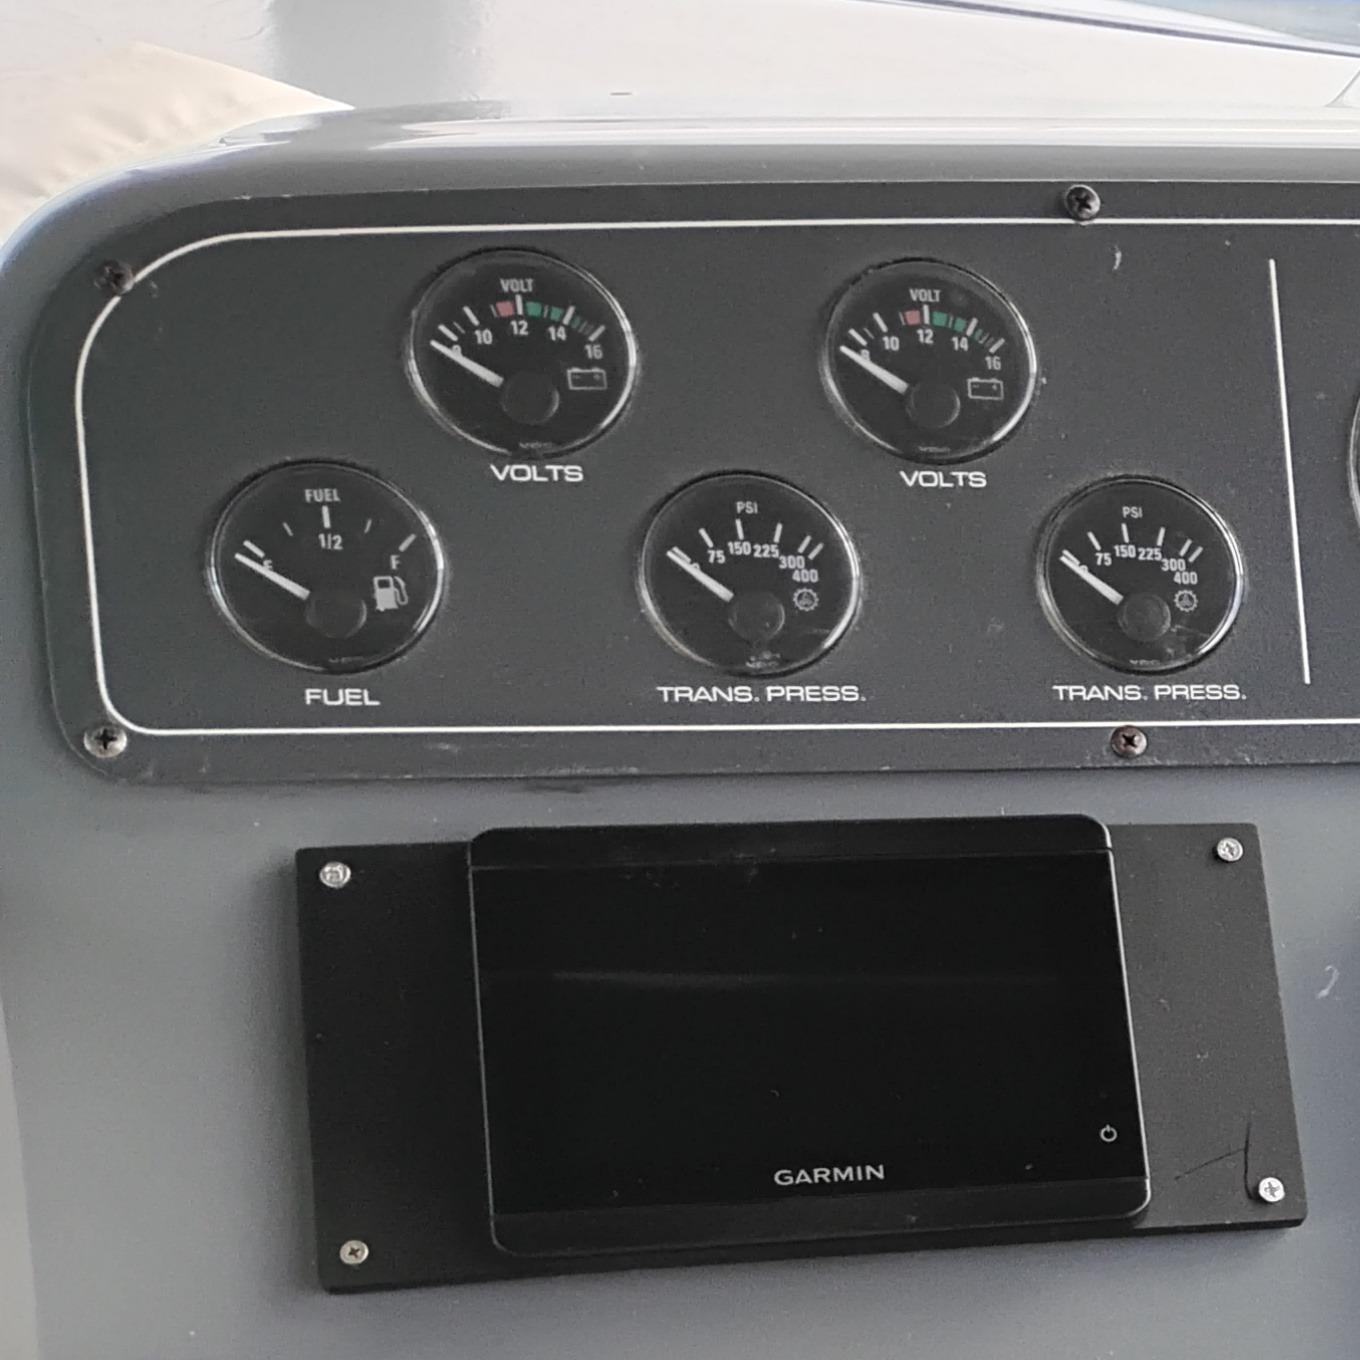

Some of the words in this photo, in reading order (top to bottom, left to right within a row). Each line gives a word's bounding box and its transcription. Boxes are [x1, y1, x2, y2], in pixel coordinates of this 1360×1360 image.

[500, 278, 534, 292] VOLT
[909, 288, 941, 302] VOLT
[510, 320, 529, 336] 12
[548, 326, 567, 341] 14
[475, 328, 492, 345] 10
[882, 336, 900, 351] 10
[916, 328, 934, 344] 12
[585, 344, 603, 359] 16
[952, 337, 969, 351] 14
[985, 356, 1001, 370] 16
[490, 464, 584, 482] VOLTS
[900, 470, 987, 488] VOLTS
[304, 488, 341, 503] FUEL
[736, 501, 758, 515] PSI
[1122, 506, 1143, 519] PSI
[318, 533, 343, 551] 1/2
[728, 541, 751, 556] 150
[707, 550, 726, 564] 75
[753, 544, 780, 558] 225
[1114, 545, 1136, 558] 150
[1138, 547, 1162, 561] 225
[778, 555, 805, 570] 300
[1095, 552, 1112, 567] 75
[1161, 558, 1186, 572] 300
[791, 569, 819, 583] 400
[1173, 571, 1198, 585] 400
[305, 688, 380, 706] FUEL
[657, 685, 760, 702] TRANS.
[766, 685, 866, 702] PRESS.
[1052, 684, 1147, 701] TRANS.
[1153, 684, 1247, 701] PRESS.
[773, 1163, 885, 1188] GARMIN
